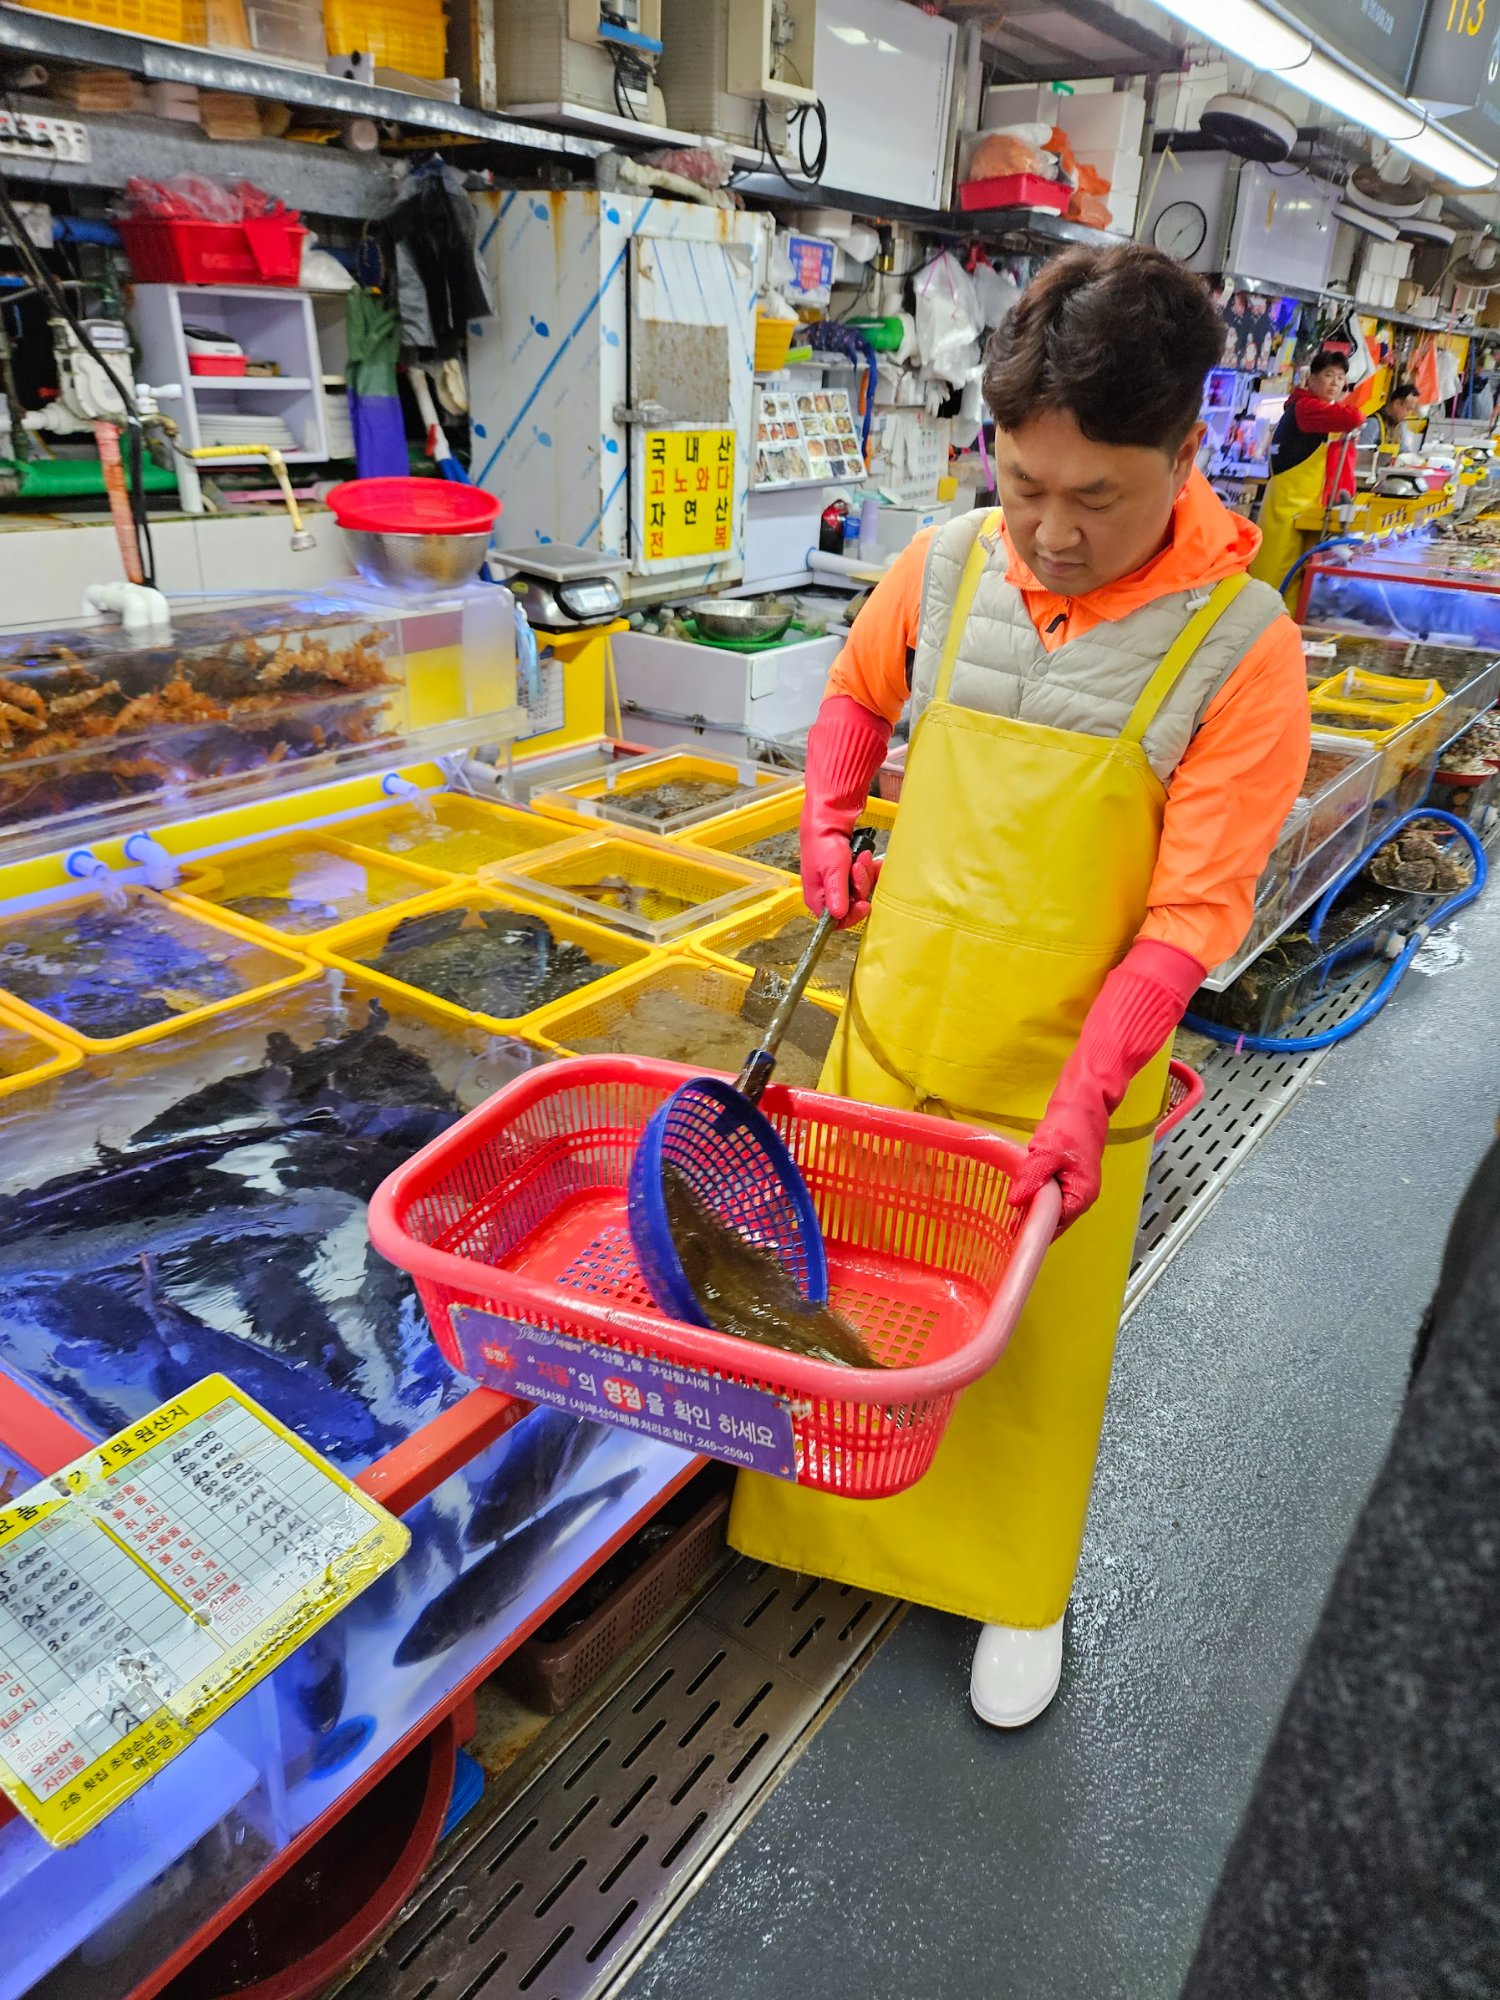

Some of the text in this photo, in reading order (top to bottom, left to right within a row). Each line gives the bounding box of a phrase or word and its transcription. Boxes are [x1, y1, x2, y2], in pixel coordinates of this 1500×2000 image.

[651, 465, 731, 495] 고노와다
[515, 1381, 566, 1406] 자갈치시장
[111, 1440, 136, 1458] 및
[134, 1404, 190, 1443] 원산지
[673, 1399, 712, 1431] 확인
[718, 1413, 777, 1449] 하세요
[218, 1594, 254, 1624] 도다리
[230, 1605, 265, 1637] 아나구
[17, 1730, 62, 1764] 히라스
[31, 1739, 75, 1778] 오징어
[42, 1755, 87, 1792] 자리돔
[59, 1791, 82, 1812] 2층
